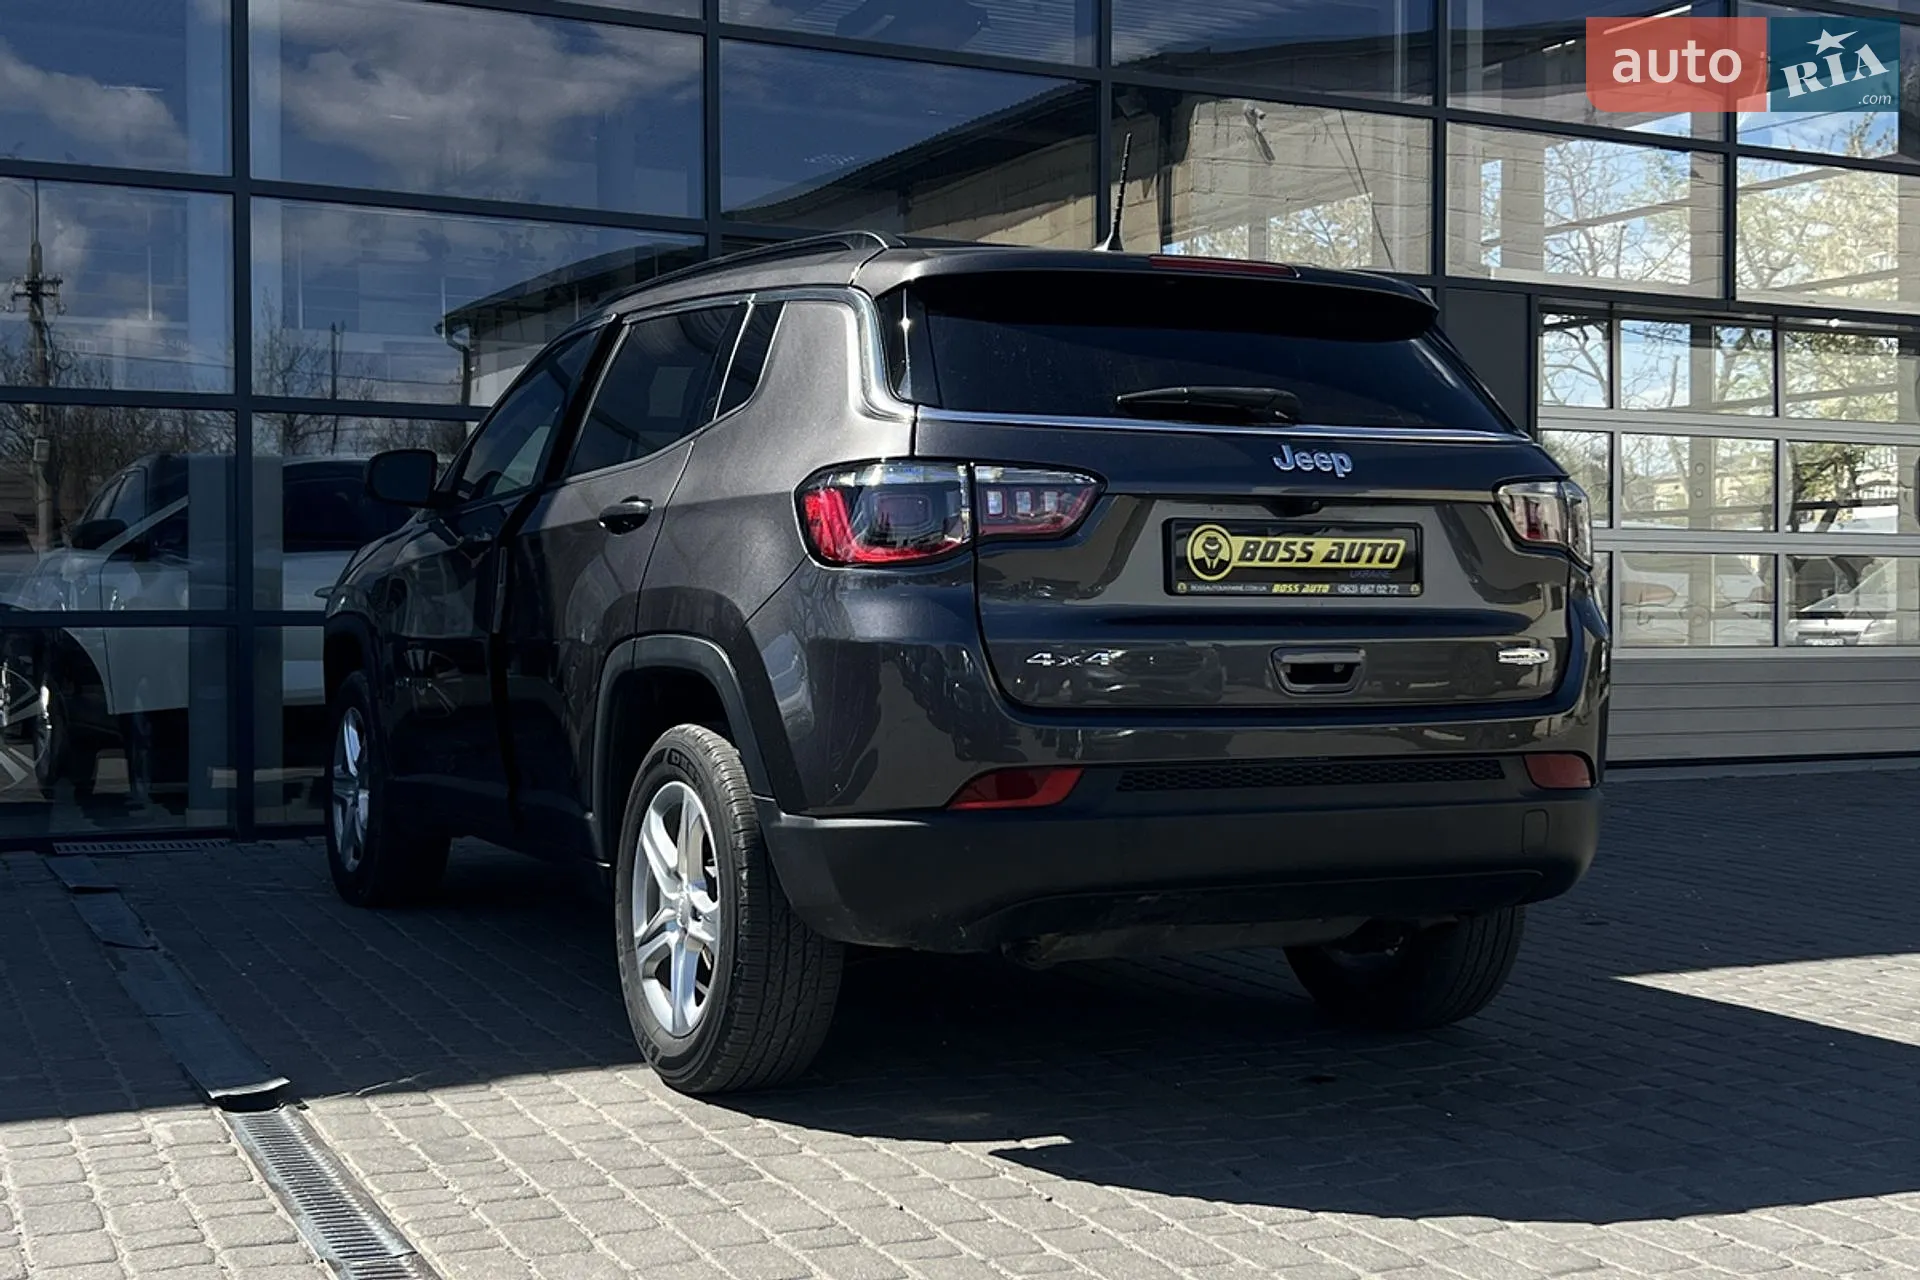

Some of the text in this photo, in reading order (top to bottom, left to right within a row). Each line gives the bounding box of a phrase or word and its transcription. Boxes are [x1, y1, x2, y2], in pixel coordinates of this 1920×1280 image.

[1273, 444, 1352, 477] Jeep
[1237, 540, 1401, 564] BOSS AUTO
[1271, 583, 1331, 593] BOSS AUTO
